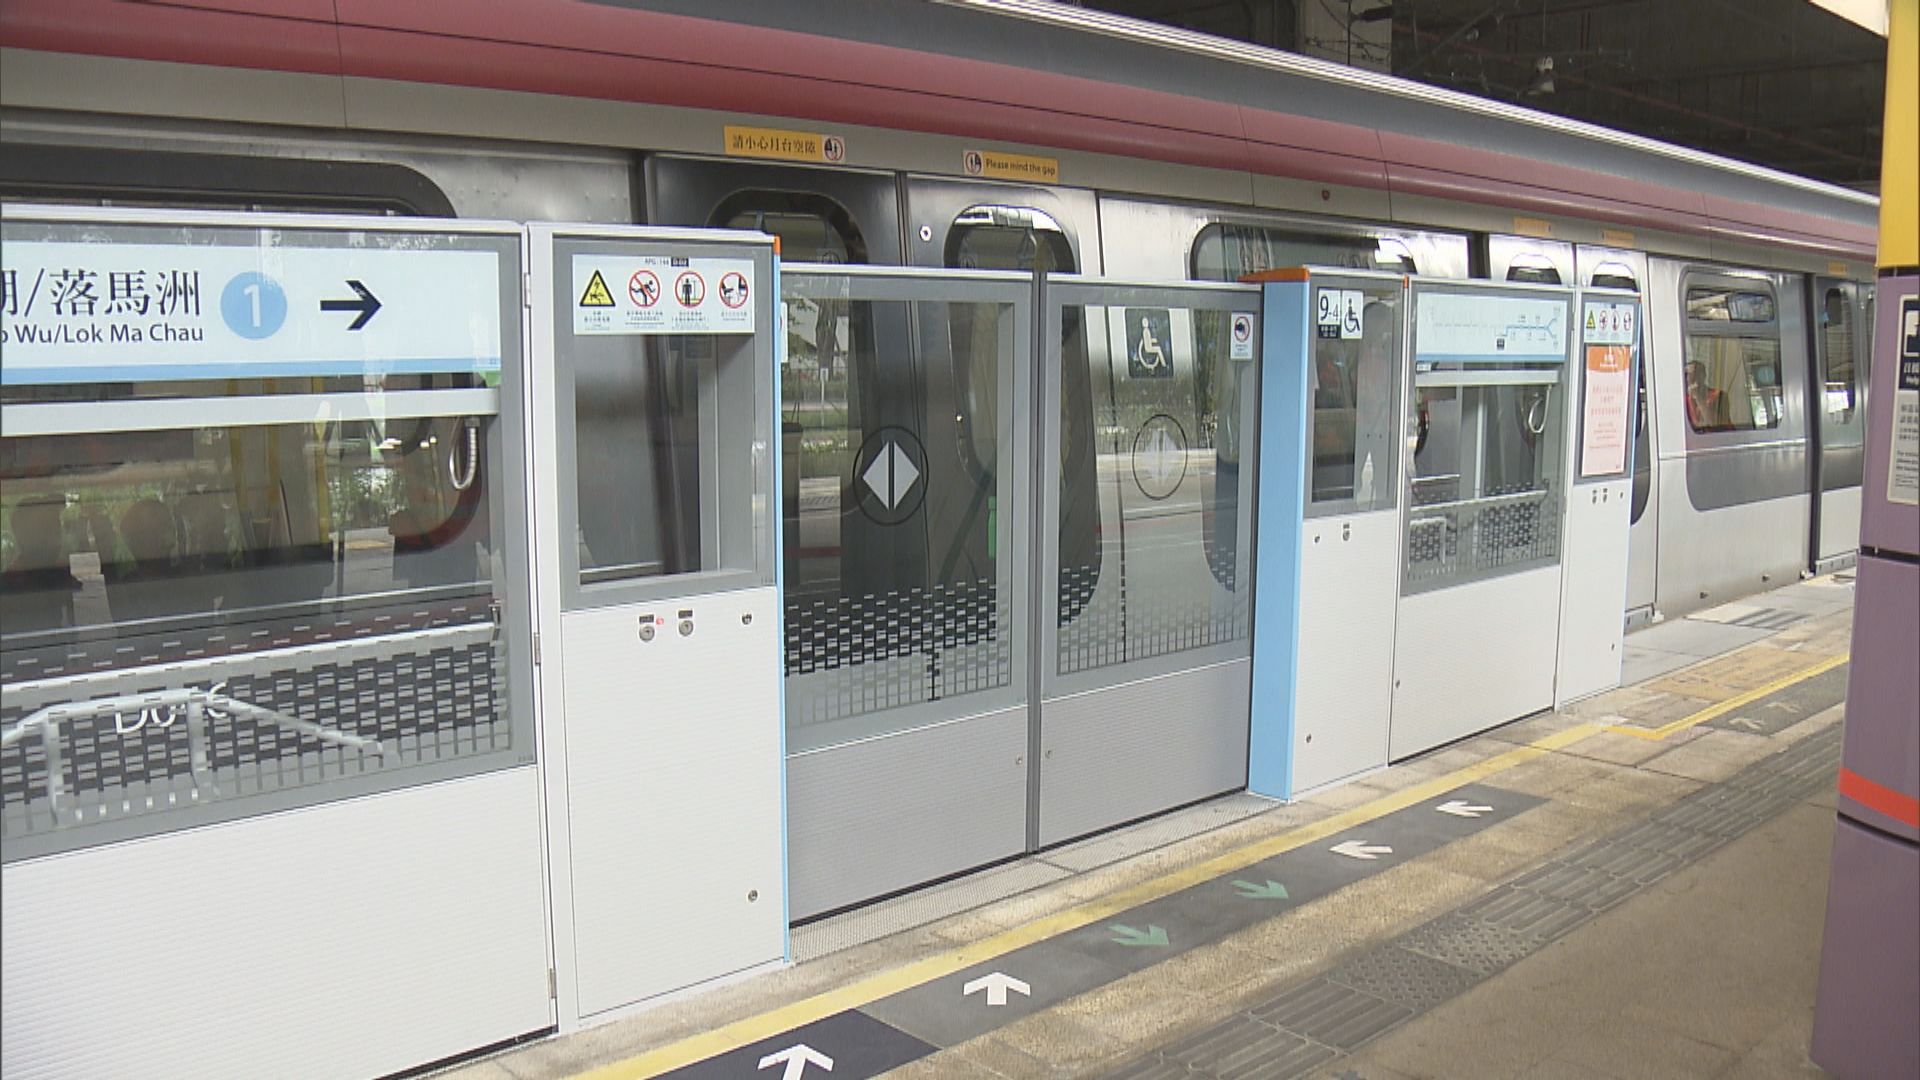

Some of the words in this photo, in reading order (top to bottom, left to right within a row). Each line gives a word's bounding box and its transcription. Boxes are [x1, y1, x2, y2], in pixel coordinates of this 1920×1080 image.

[986, 158, 1009, 170] Please
[1010, 161, 1028, 172] mind
[1029, 164, 1041, 173] the
[1041, 166, 1056, 177] gap
[244, 285, 262, 328] 1
[14, 323, 104, 345] Wu/Lok
[110, 323, 143, 342] Ma
[149, 322, 204, 342] Chau
